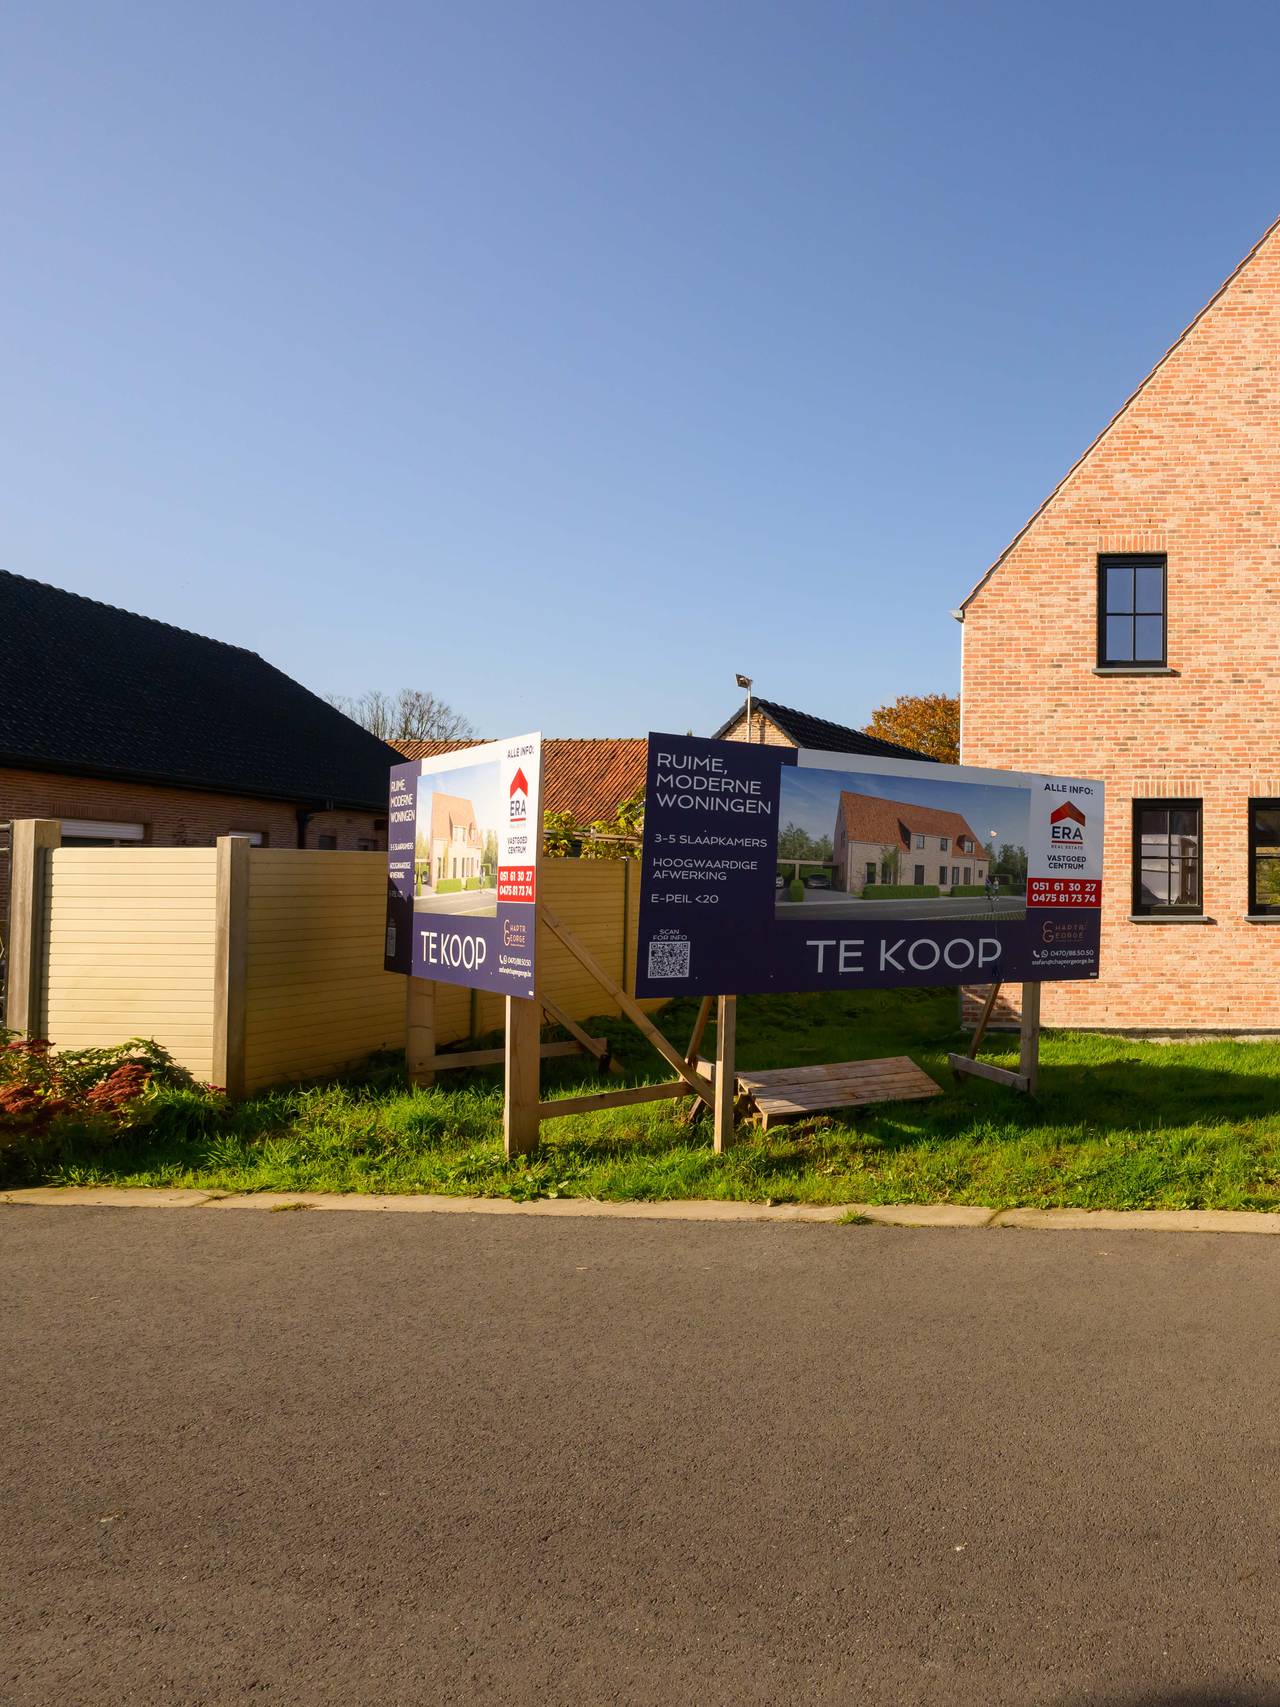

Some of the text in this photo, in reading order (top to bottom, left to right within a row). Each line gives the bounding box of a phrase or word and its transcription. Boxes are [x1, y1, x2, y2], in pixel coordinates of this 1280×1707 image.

[507, 748, 519, 759] ALLE
[657, 753, 728, 774] RUIME,
[656, 774, 761, 794] MODERNE
[1044, 783, 1094, 795] ALLE INFO:
[510, 799, 526, 816] ERA
[656, 793, 771, 814] WONINGEN
[1051, 825, 1083, 840] ERA
[654, 833, 768, 848] 3-5 SLAAPKAMERS
[653, 858, 758, 870] HOOGWAARDIGE
[1047, 854, 1087, 863] VASTGOED
[1048, 862, 1084, 870] CENTRUM
[500, 871, 533, 881] 051 61 30 27
[653, 870, 728, 881] AFWERKING
[499, 885, 512, 895] 0475
[519, 885, 525, 896] 73
[525, 885, 533, 896] 74
[1032, 882, 1097, 892] 051 61 30 27
[651, 893, 719, 904] E-PEIL <20
[1032, 893, 1096, 903] 0475 81 73 74
[420, 931, 487, 970] TE KOOP
[806, 938, 1002, 973] TE KOOP
